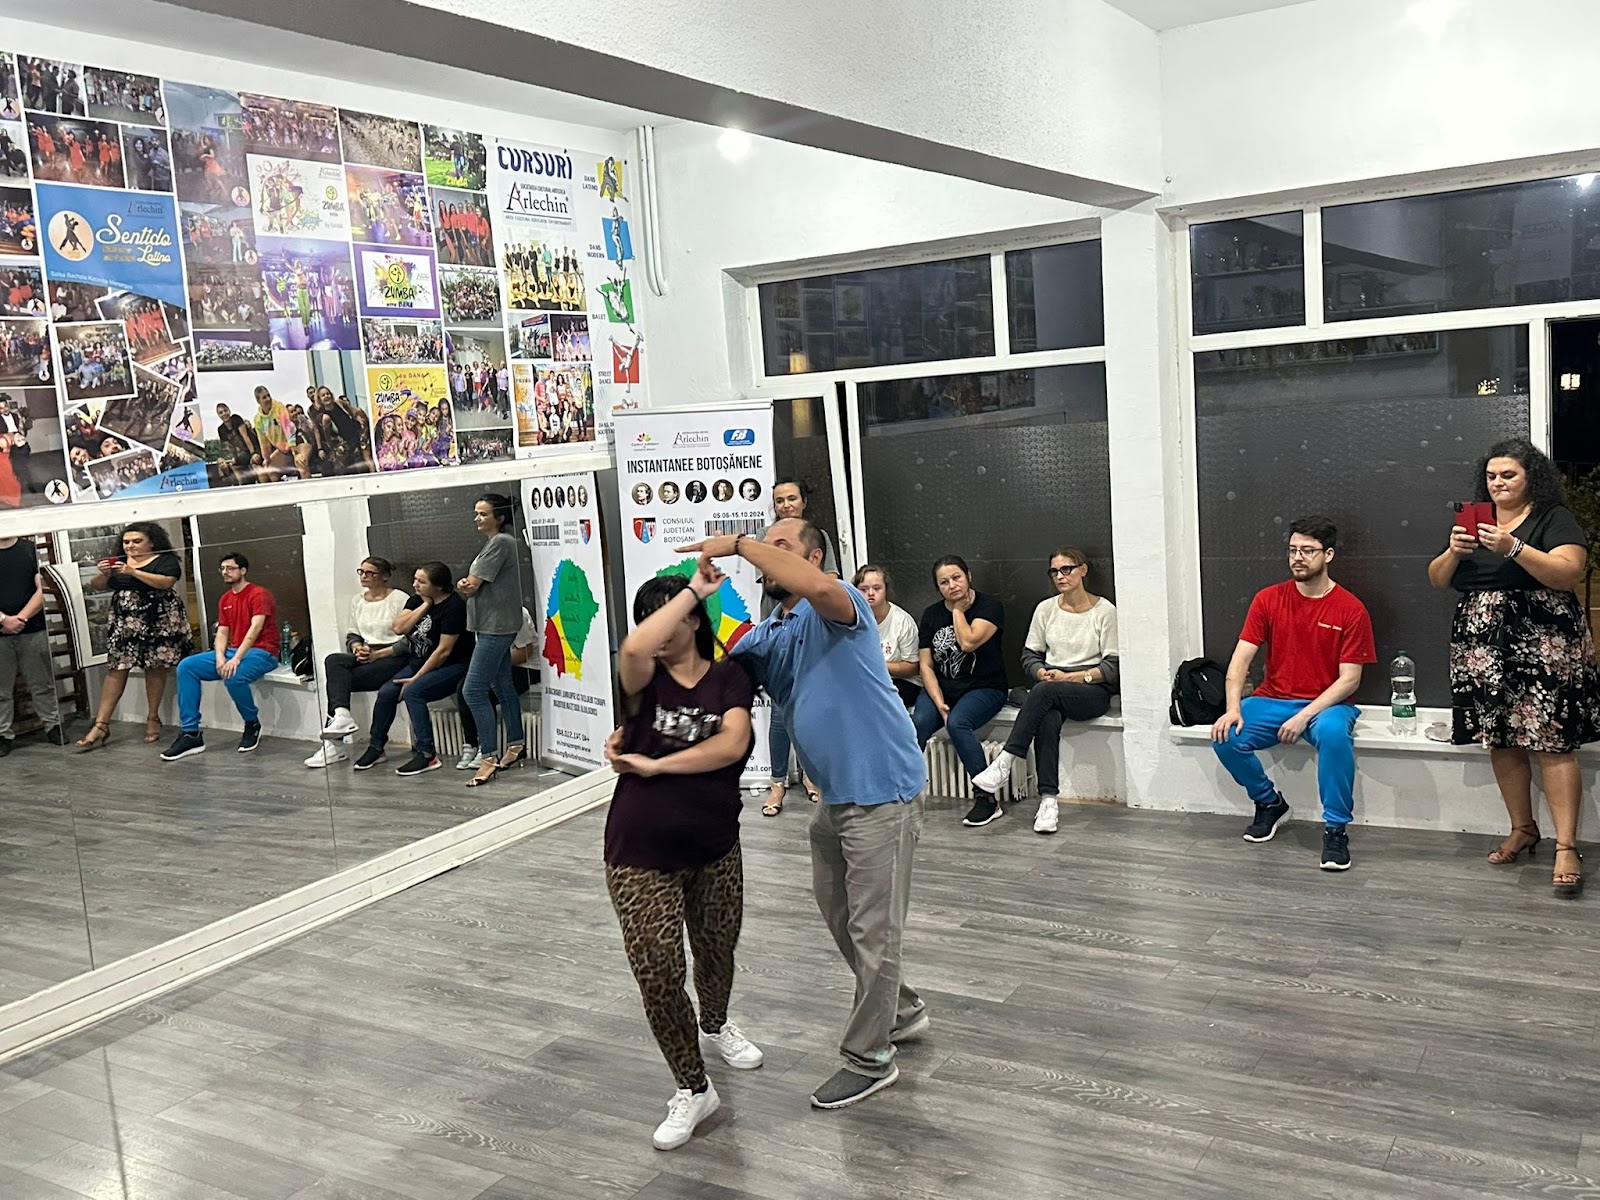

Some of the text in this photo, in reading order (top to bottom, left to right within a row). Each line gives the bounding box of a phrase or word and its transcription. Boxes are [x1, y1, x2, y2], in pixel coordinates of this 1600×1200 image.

[497, 146, 572, 180] CURSURI
[506, 181, 568, 213] Arlechin
[96, 214, 172, 246] Sentido
[137, 245, 172, 266] Latino
[384, 285, 415, 300] ZUMBA
[375, 392, 401, 404] ZUMBA
[674, 431, 709, 445] Arlechin
[627, 454, 763, 474] INSTANTANEE BOTOȘĂNENE
[662, 517, 695, 525] CONSILIUL
[713, 511, 765, 519] 05.06-15.10.2024
